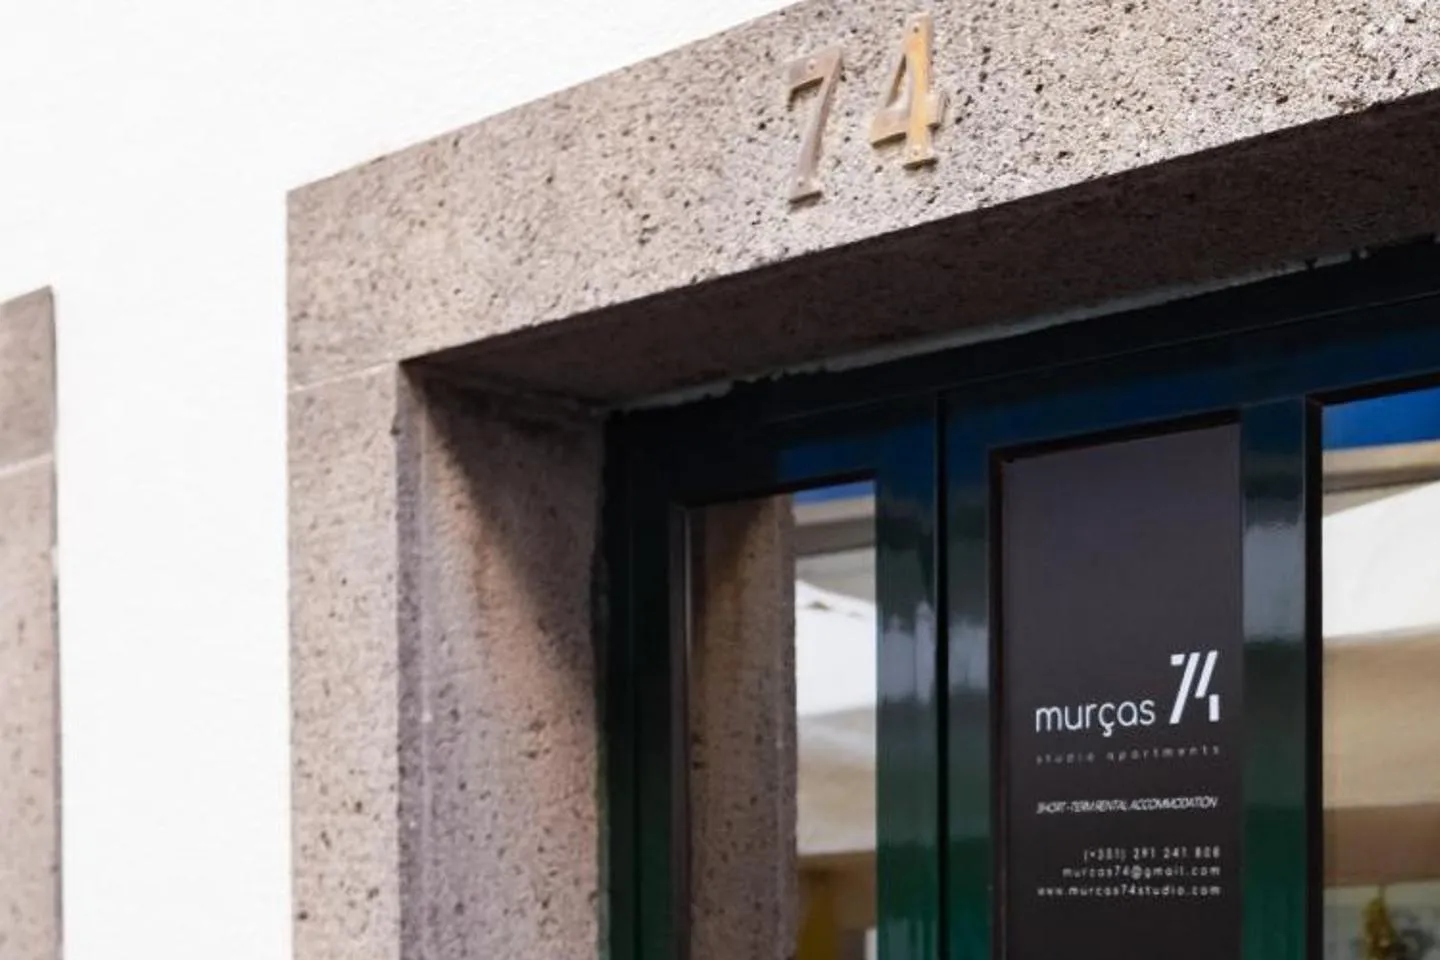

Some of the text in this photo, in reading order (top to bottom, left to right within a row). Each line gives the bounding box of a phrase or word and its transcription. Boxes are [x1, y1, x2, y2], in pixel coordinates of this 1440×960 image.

[783, 12, 951, 204] 74
[1035, 651, 1219, 737] murças 74
[1105, 745, 1220, 761] apartments
